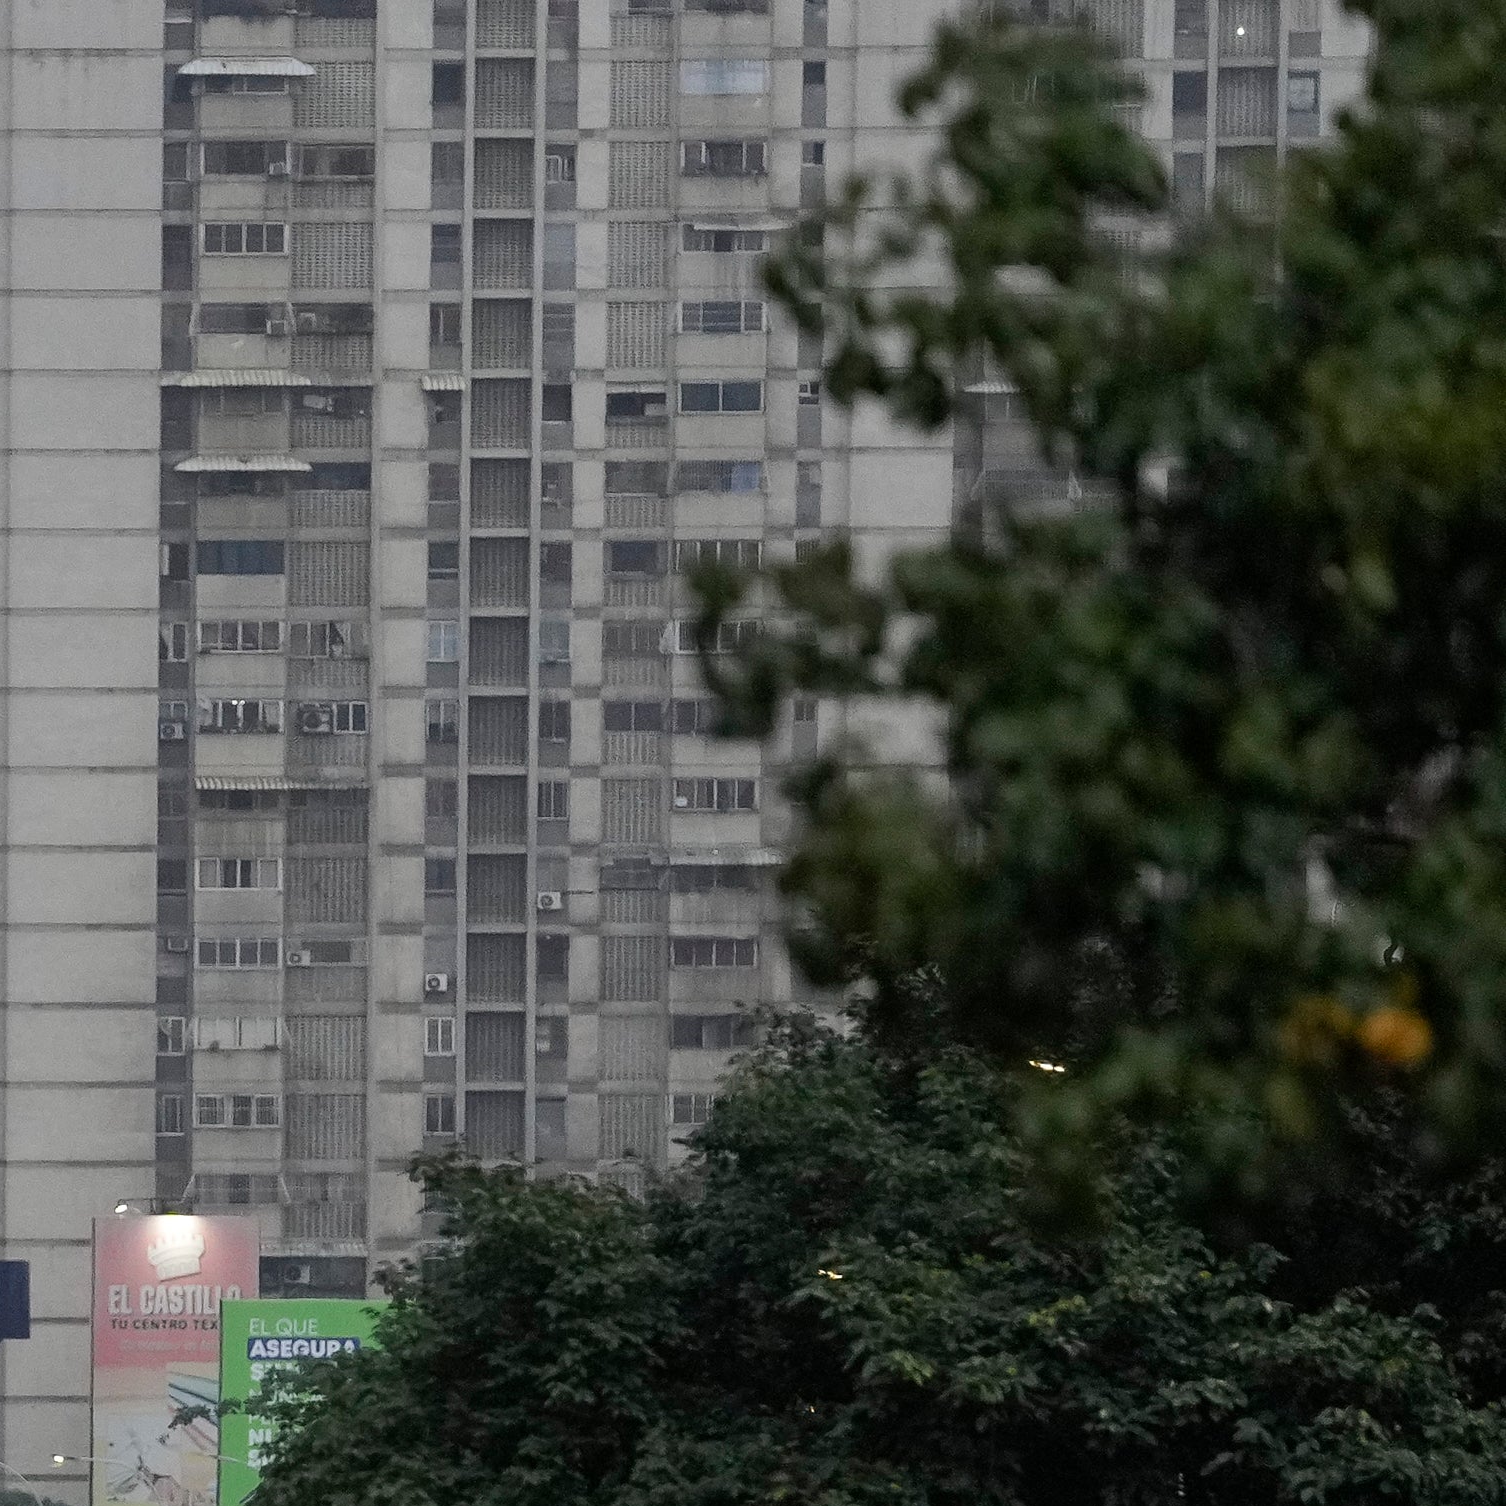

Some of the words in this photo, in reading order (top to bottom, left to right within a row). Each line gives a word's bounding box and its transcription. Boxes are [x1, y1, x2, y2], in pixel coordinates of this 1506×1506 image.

[108, 1284, 133, 1315] EL
[112, 1318, 128, 1330] TU
[133, 1318, 188, 1331] CENTRO
[249, 1318, 271, 1335] EL
[276, 1318, 319, 1337] QUE
